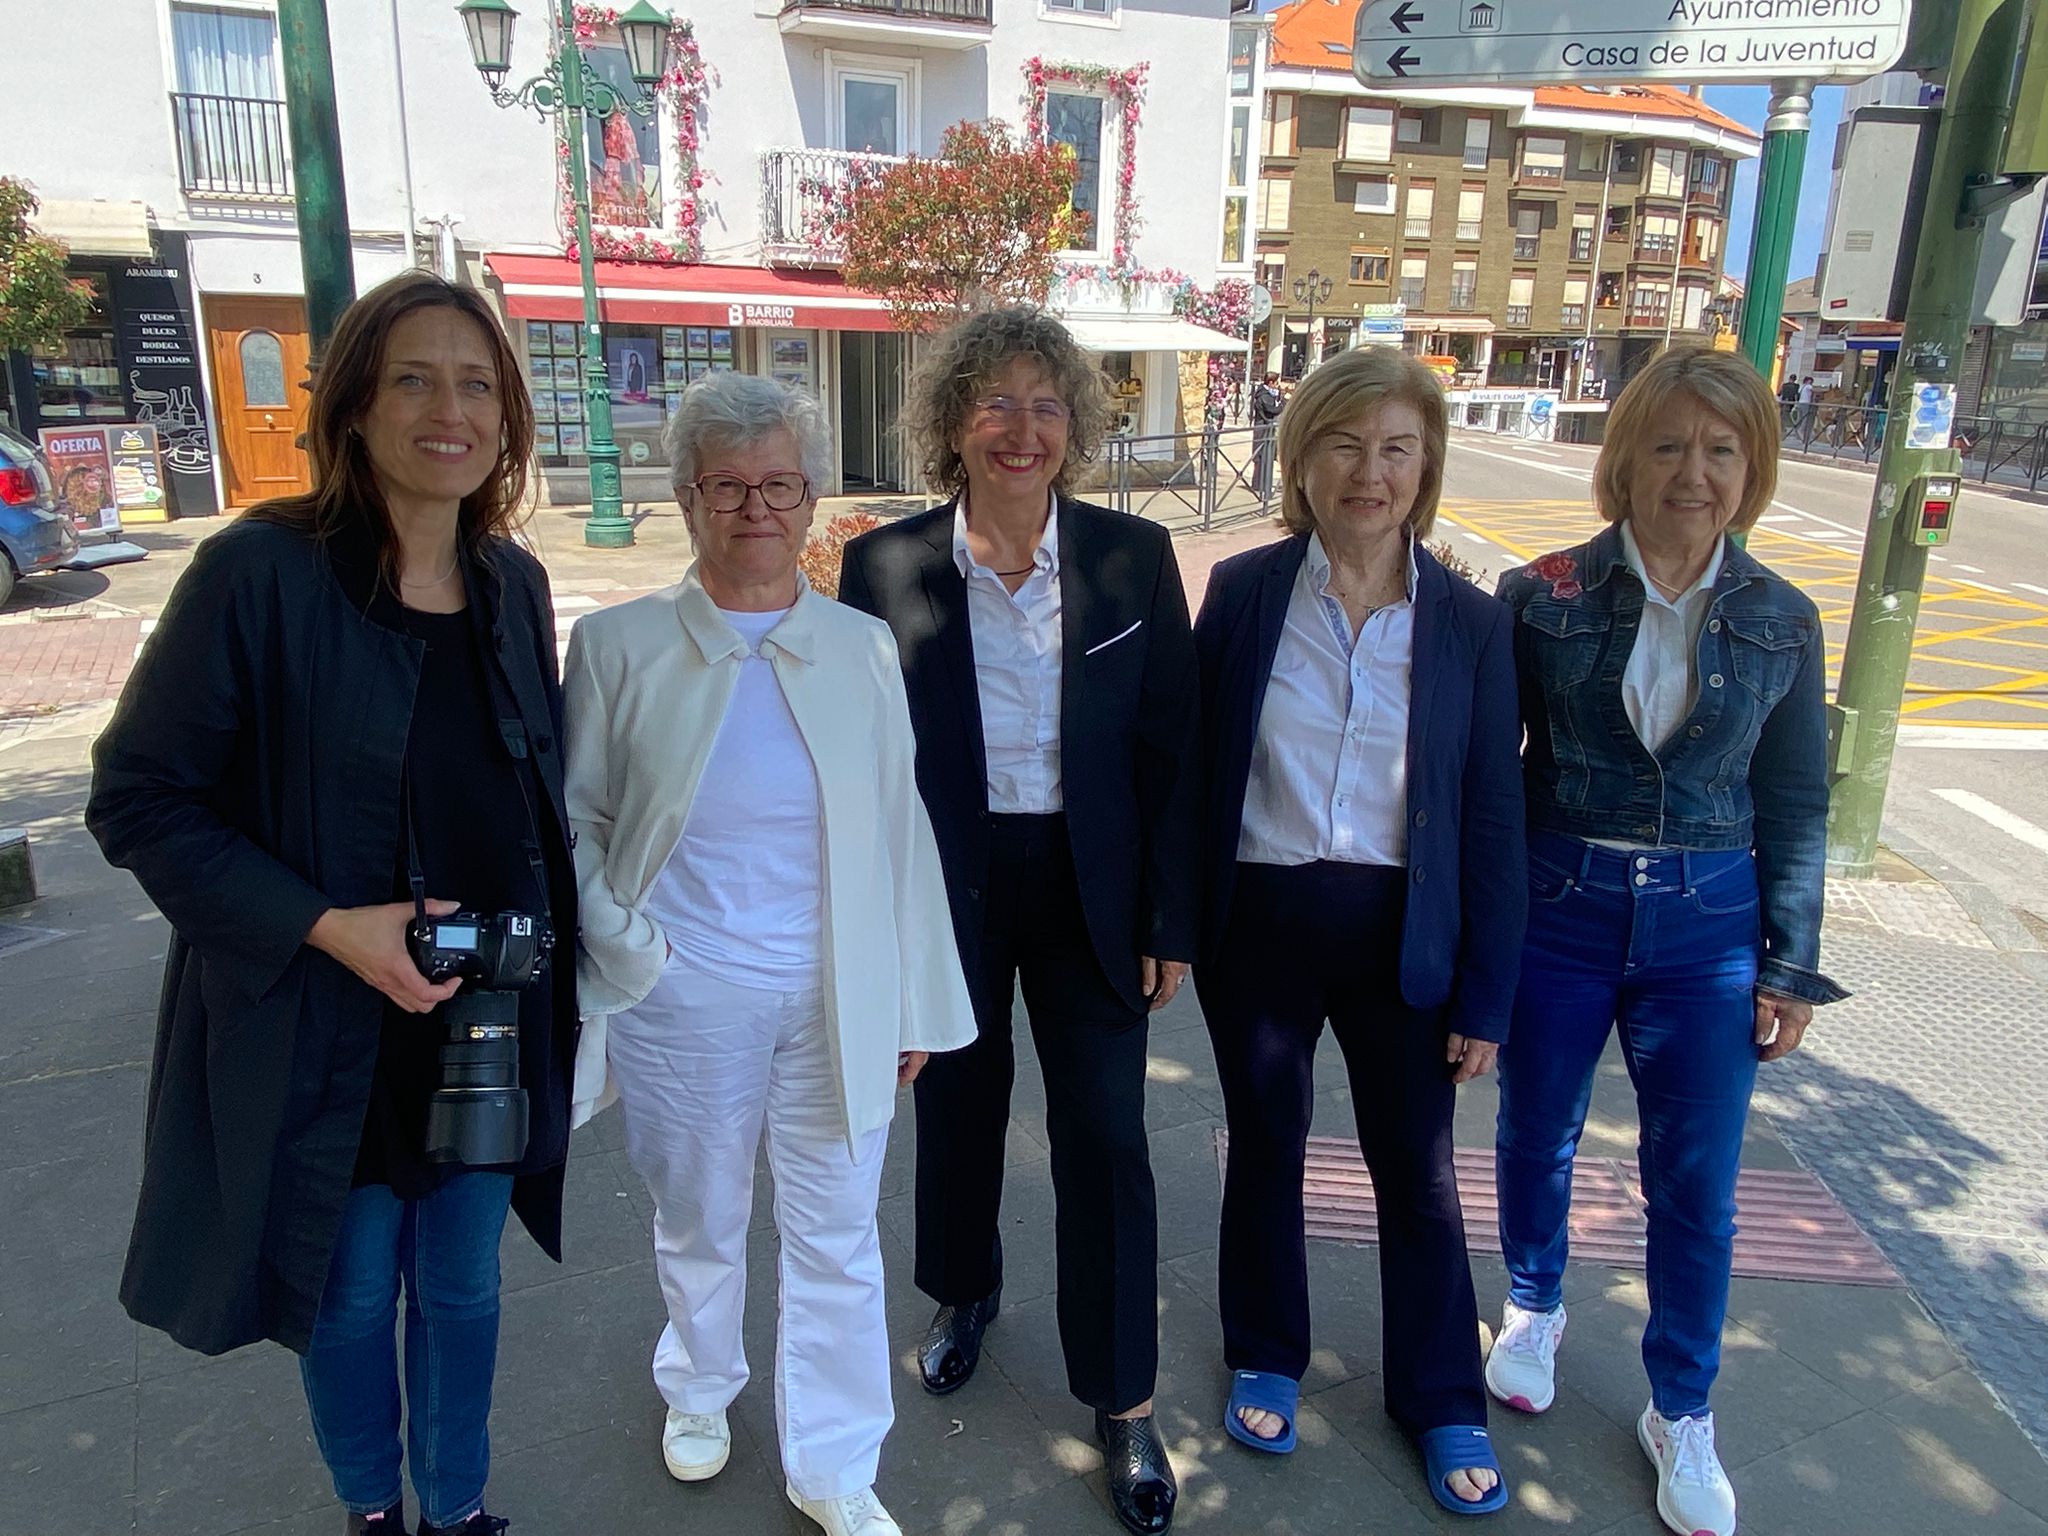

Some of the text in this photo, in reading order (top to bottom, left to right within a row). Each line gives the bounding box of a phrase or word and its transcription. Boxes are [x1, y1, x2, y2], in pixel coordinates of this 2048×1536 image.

[1668, 0, 1880, 25] Ayuntamiento
[1562, 35, 1877, 66] Casa de la Juventud
[125, 268, 179, 278] ARAMBURU
[253, 273, 262, 284] 3
[745, 305, 794, 318] BARRIO
[139, 313, 176, 323] QUESOS
[745, 318, 794, 327] INMOBILIARIA
[141, 327, 177, 335] DULCES
[142, 341, 180, 350] BODEGA
[135, 355, 191, 364] DESTILADOS
[50, 437, 102, 454] OFERTA
